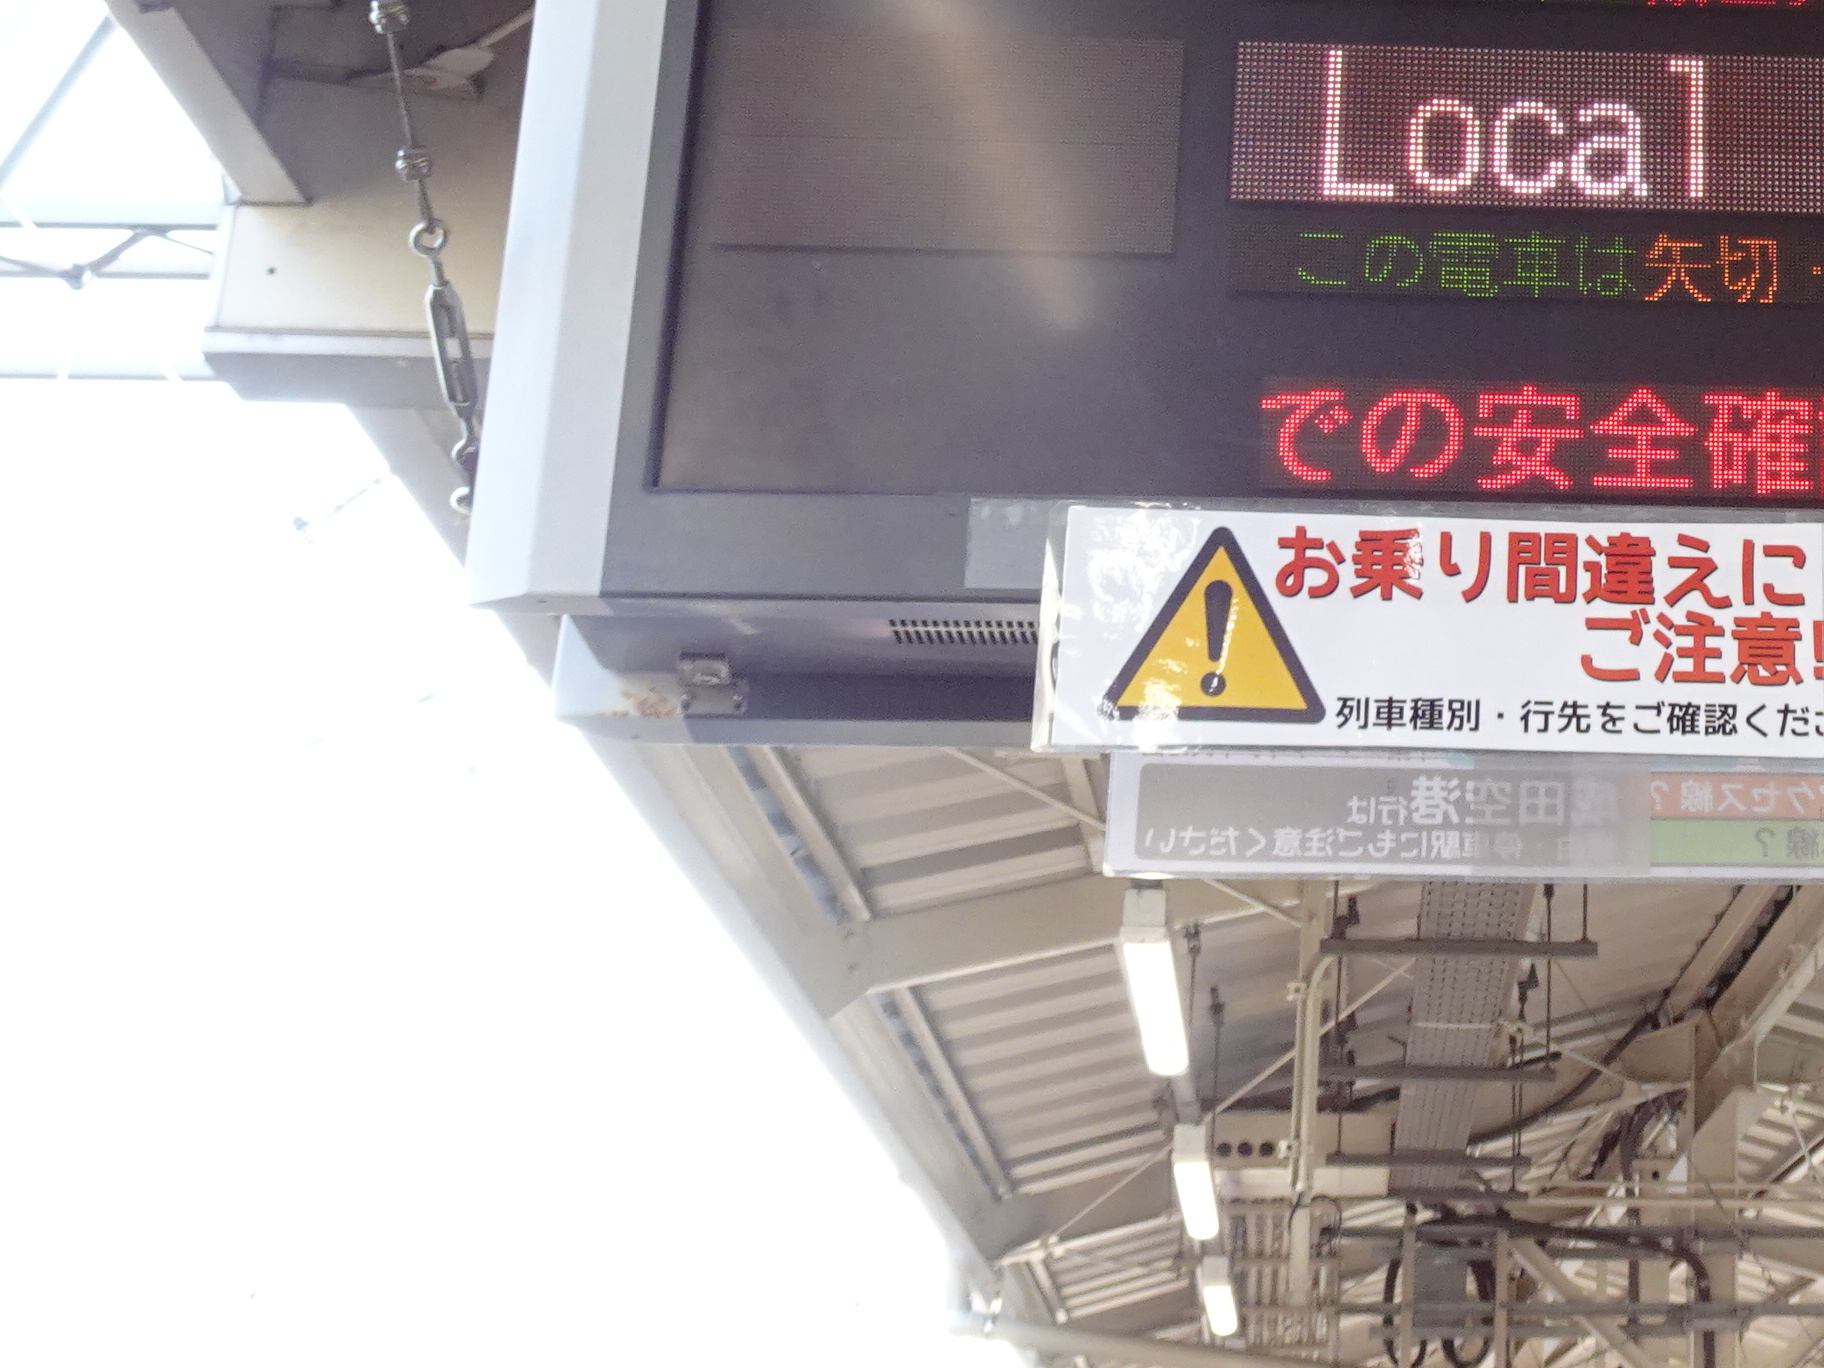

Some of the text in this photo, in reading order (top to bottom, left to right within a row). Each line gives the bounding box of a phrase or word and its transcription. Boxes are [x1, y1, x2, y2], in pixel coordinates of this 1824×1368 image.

[1321, 47, 1706, 200] Local
[1274, 525, 1807, 611] お乗り間違えに
